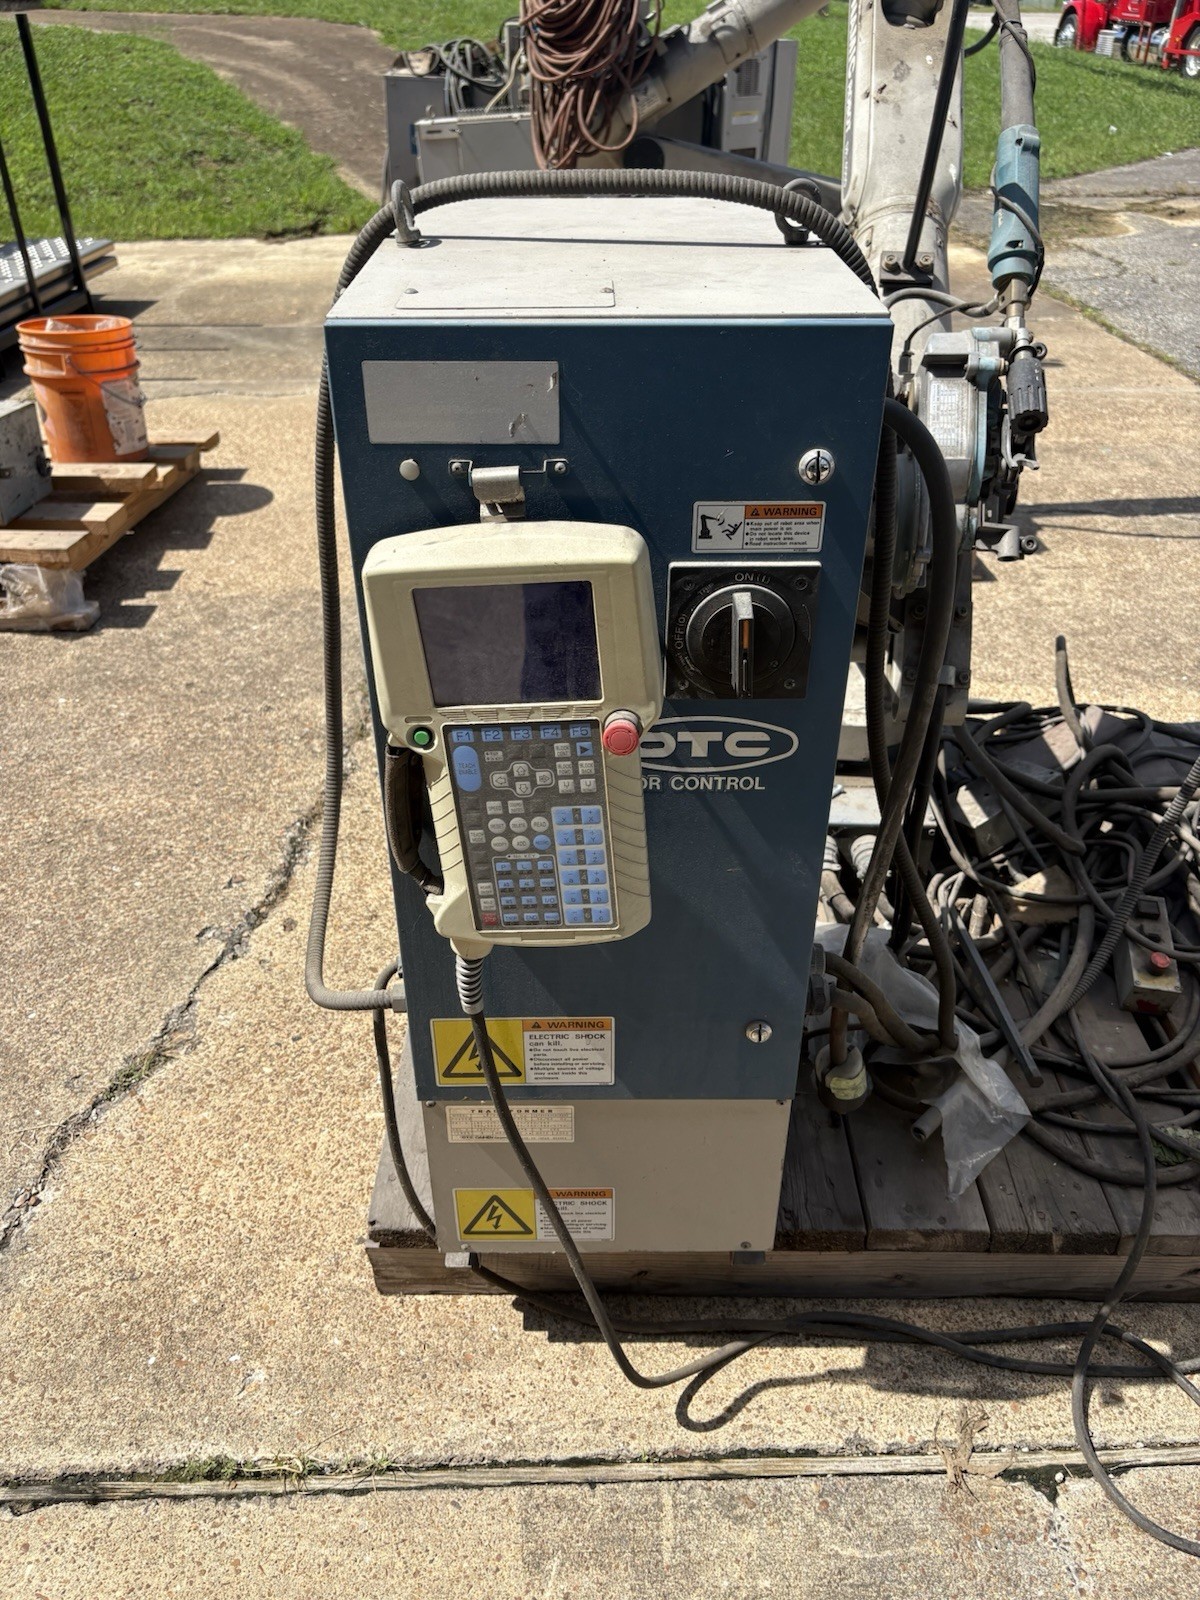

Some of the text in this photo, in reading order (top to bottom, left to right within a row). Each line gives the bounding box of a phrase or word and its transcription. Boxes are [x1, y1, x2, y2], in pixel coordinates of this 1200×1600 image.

[456, 726, 588, 740] F1 F2 F3 F4 F5
[640, 731, 771, 758] OTC
[671, 776, 766, 790] CONTROL
